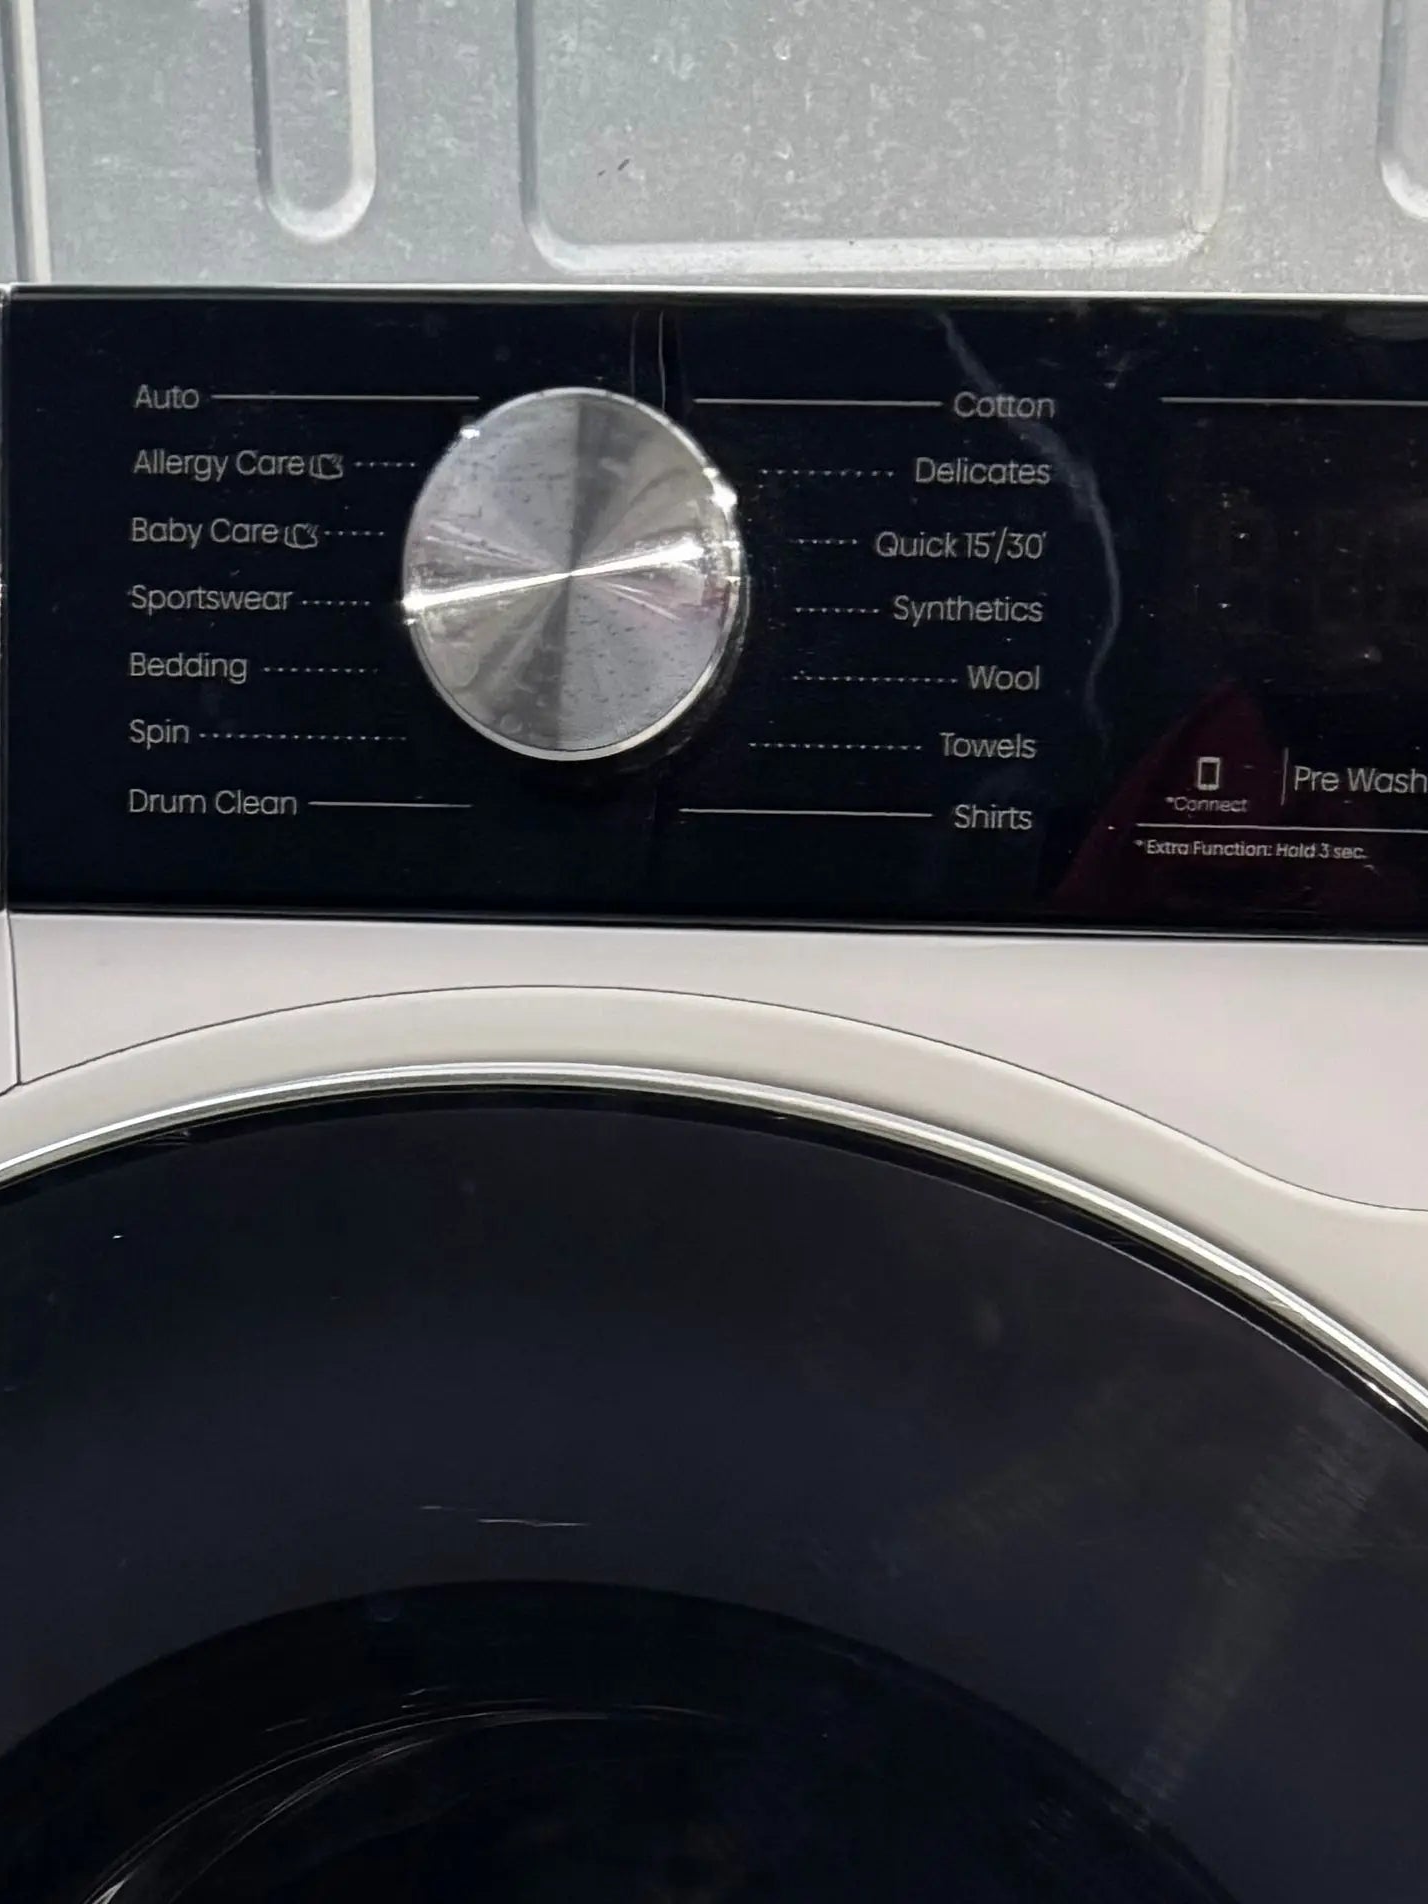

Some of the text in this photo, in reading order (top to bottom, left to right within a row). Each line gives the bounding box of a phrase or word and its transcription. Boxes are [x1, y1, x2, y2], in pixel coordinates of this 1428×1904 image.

[134, 385, 199, 409] Auto
[954, 391, 1054, 418] Cotton
[133, 450, 304, 481] Allergy Care
[915, 458, 1050, 484] Delicates
[131, 518, 277, 548] Baby Care
[876, 531, 958, 558] Quick
[131, 585, 293, 615] Sportswear
[894, 595, 1043, 628] Synthetics
[130, 653, 247, 684] Bedding
[968, 666, 1039, 690] Wool
[129, 719, 189, 749] Spin
[940, 732, 1036, 759] Towels
[1294, 767, 1428, 794] Pre Wash
[129, 789, 297, 815] Drum Clean
[954, 804, 1032, 830] Shirts
[1276, 843, 1315, 859] Hold
[1319, 843, 1330, 859] 3
